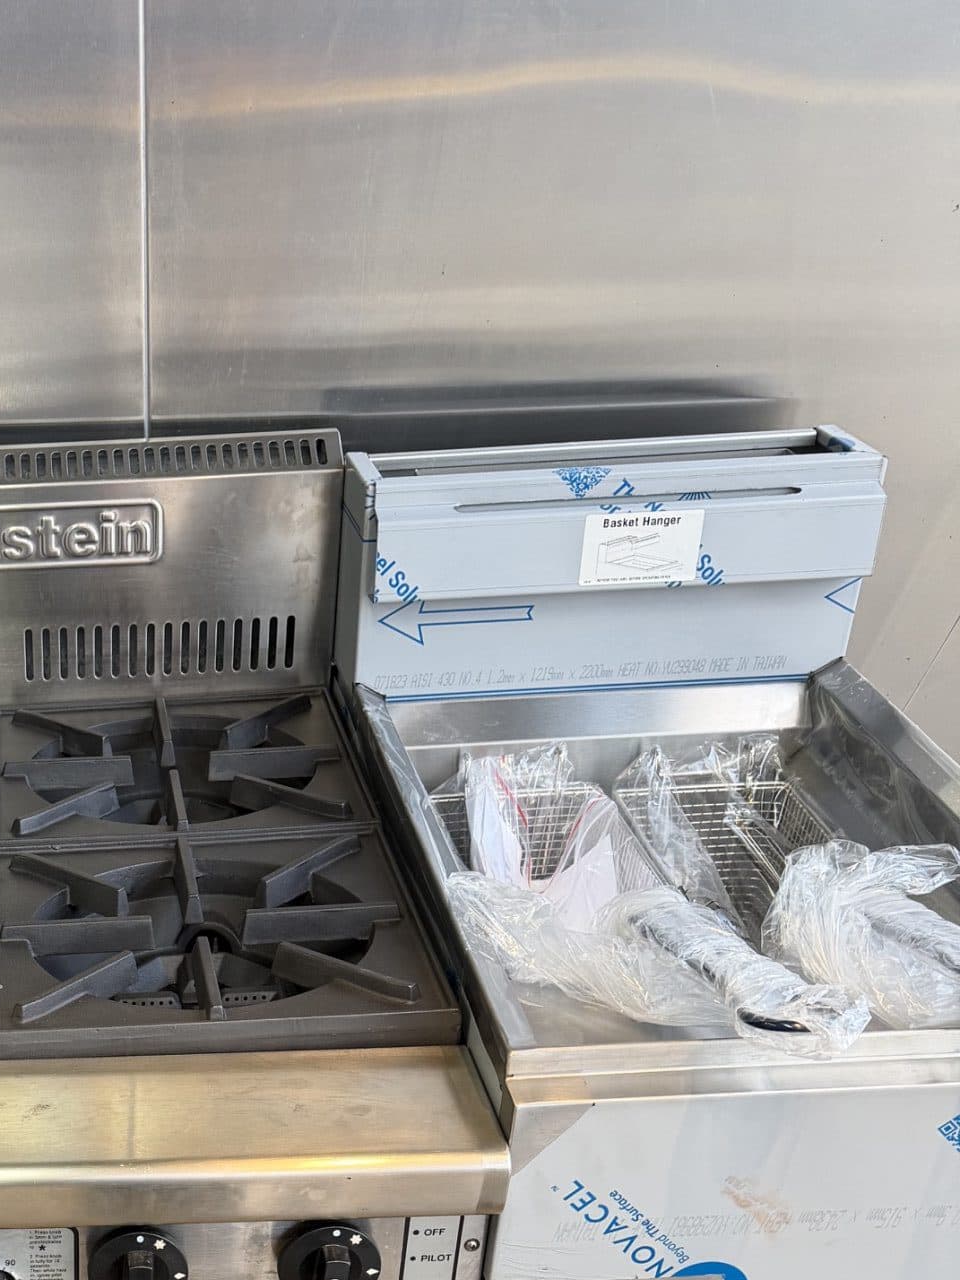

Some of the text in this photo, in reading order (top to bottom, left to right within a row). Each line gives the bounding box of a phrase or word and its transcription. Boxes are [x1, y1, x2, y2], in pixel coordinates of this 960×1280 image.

[602, 515, 682, 528] Basket Hanger
[609, 1189, 644, 1222] Surface
[424, 1228, 446, 1236] OFF
[563, 1180, 674, 1278] NOVACEL
[641, 1219, 659, 1237] The
[421, 1254, 452, 1262] PILOT
[657, 1235, 690, 1264] Beyond
